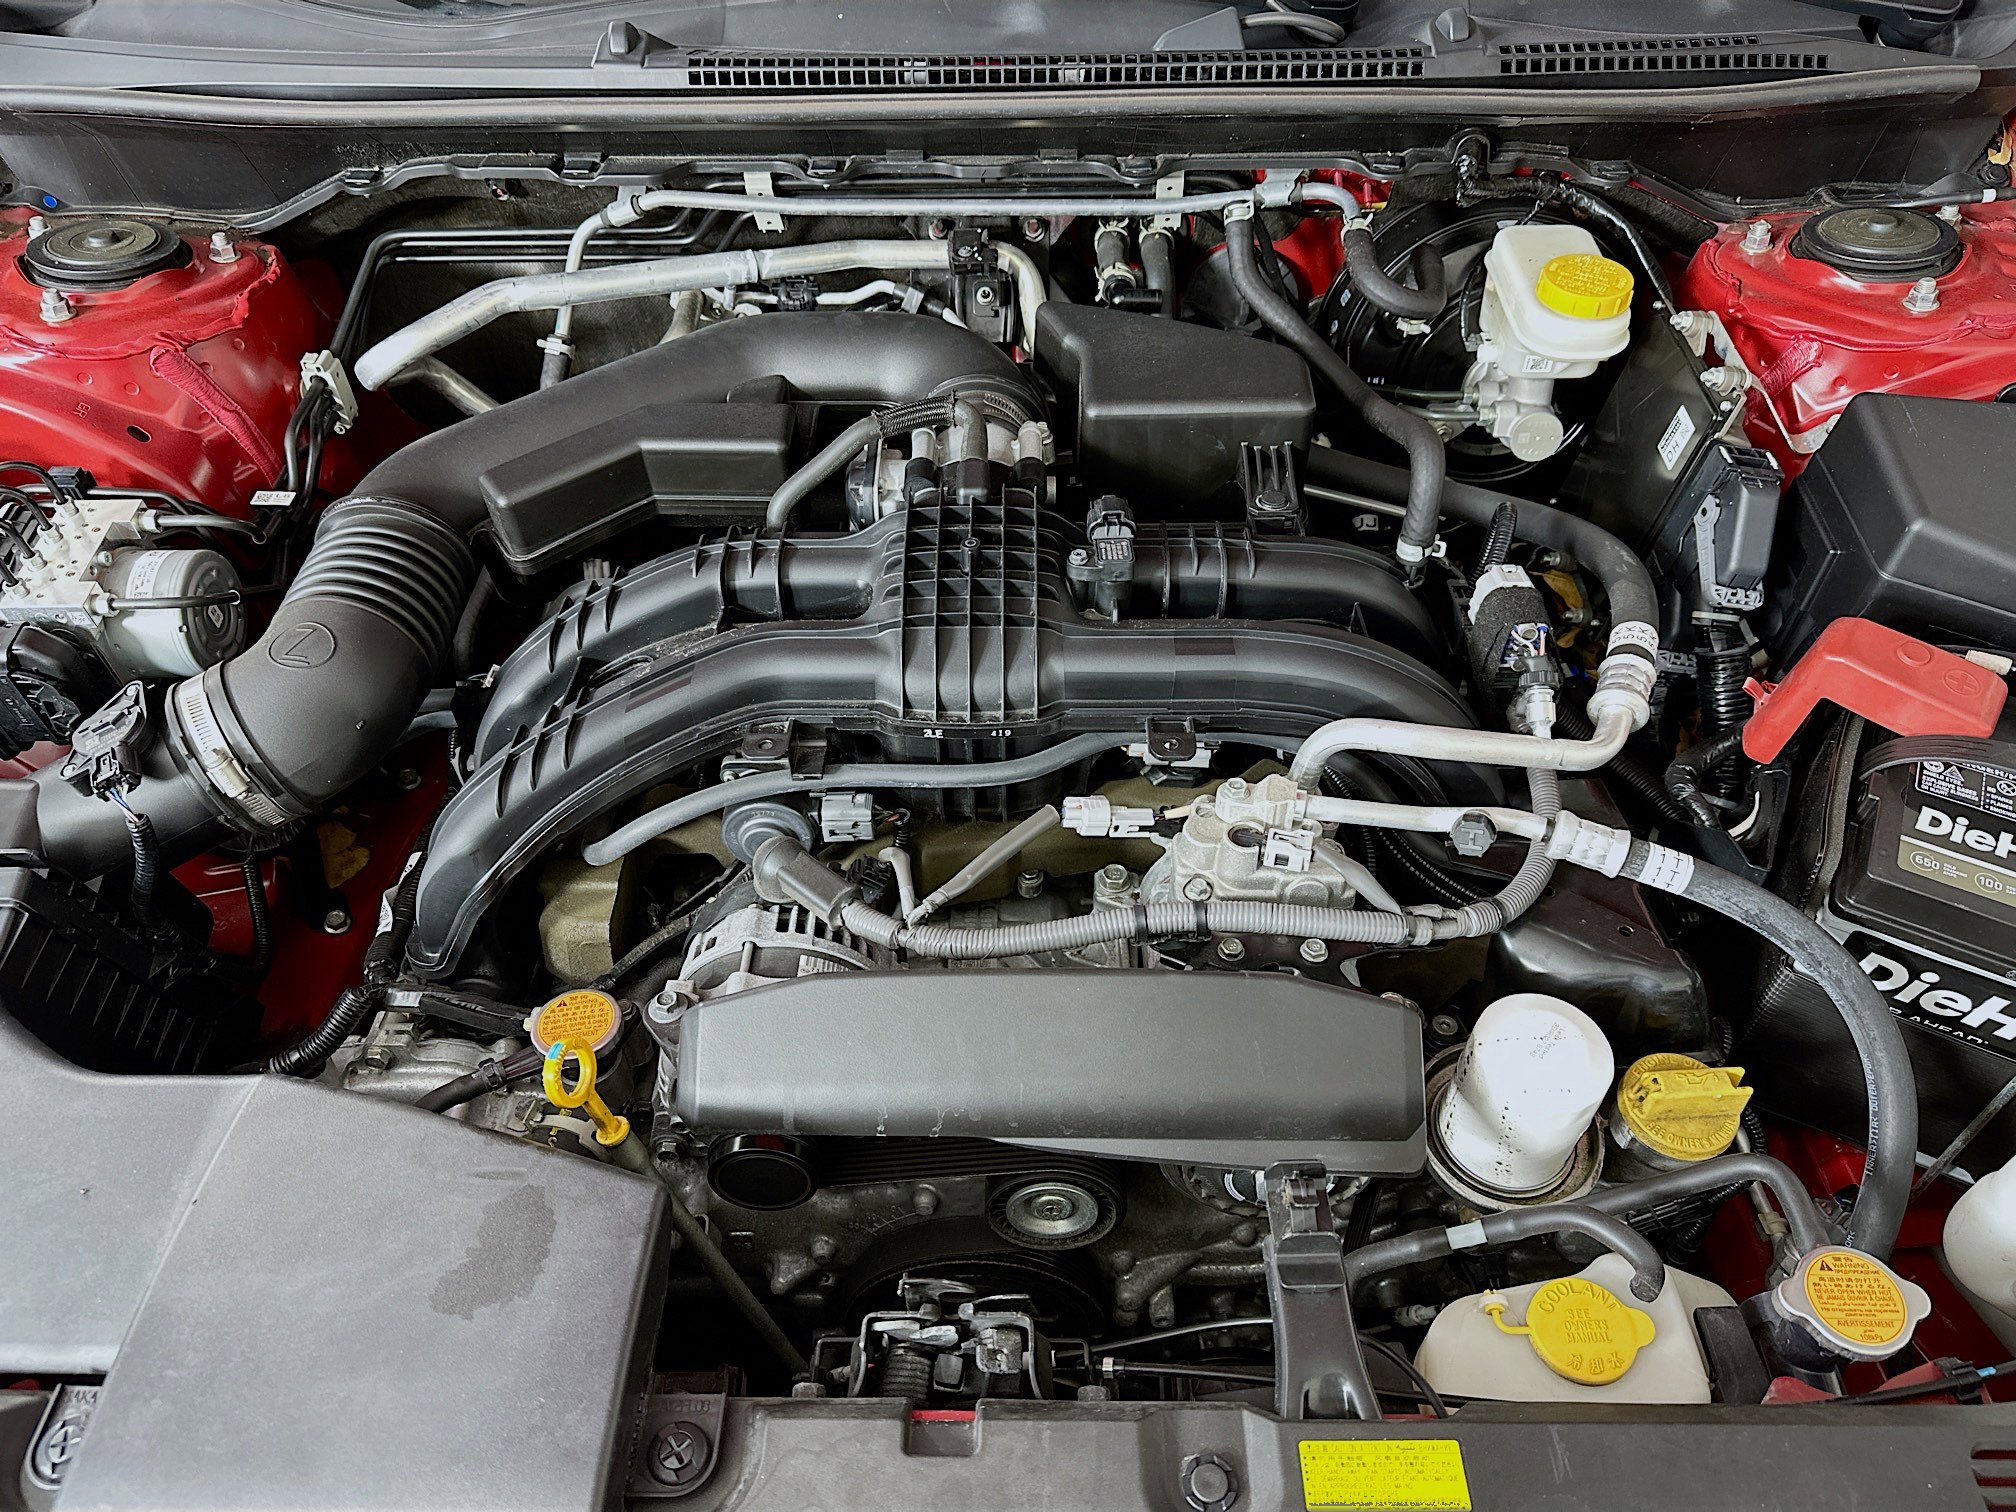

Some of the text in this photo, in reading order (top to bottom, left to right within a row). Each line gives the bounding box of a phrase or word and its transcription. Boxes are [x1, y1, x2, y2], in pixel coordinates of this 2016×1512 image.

[1915, 854, 1940, 870] 650
[1979, 876, 2003, 892] 100
[1632, 1055, 1679, 1078] ENGINE
[1646, 1122, 1665, 1139] SEE
[1832, 1262, 1870, 1270] WARNING
[1538, 1280, 1622, 1314] COOLANT
[1567, 1308, 1591, 1320] SEE
[1837, 1320, 1896, 1328] AVERTISSEMENT
[1566, 1332, 1613, 1344] MANUAL
